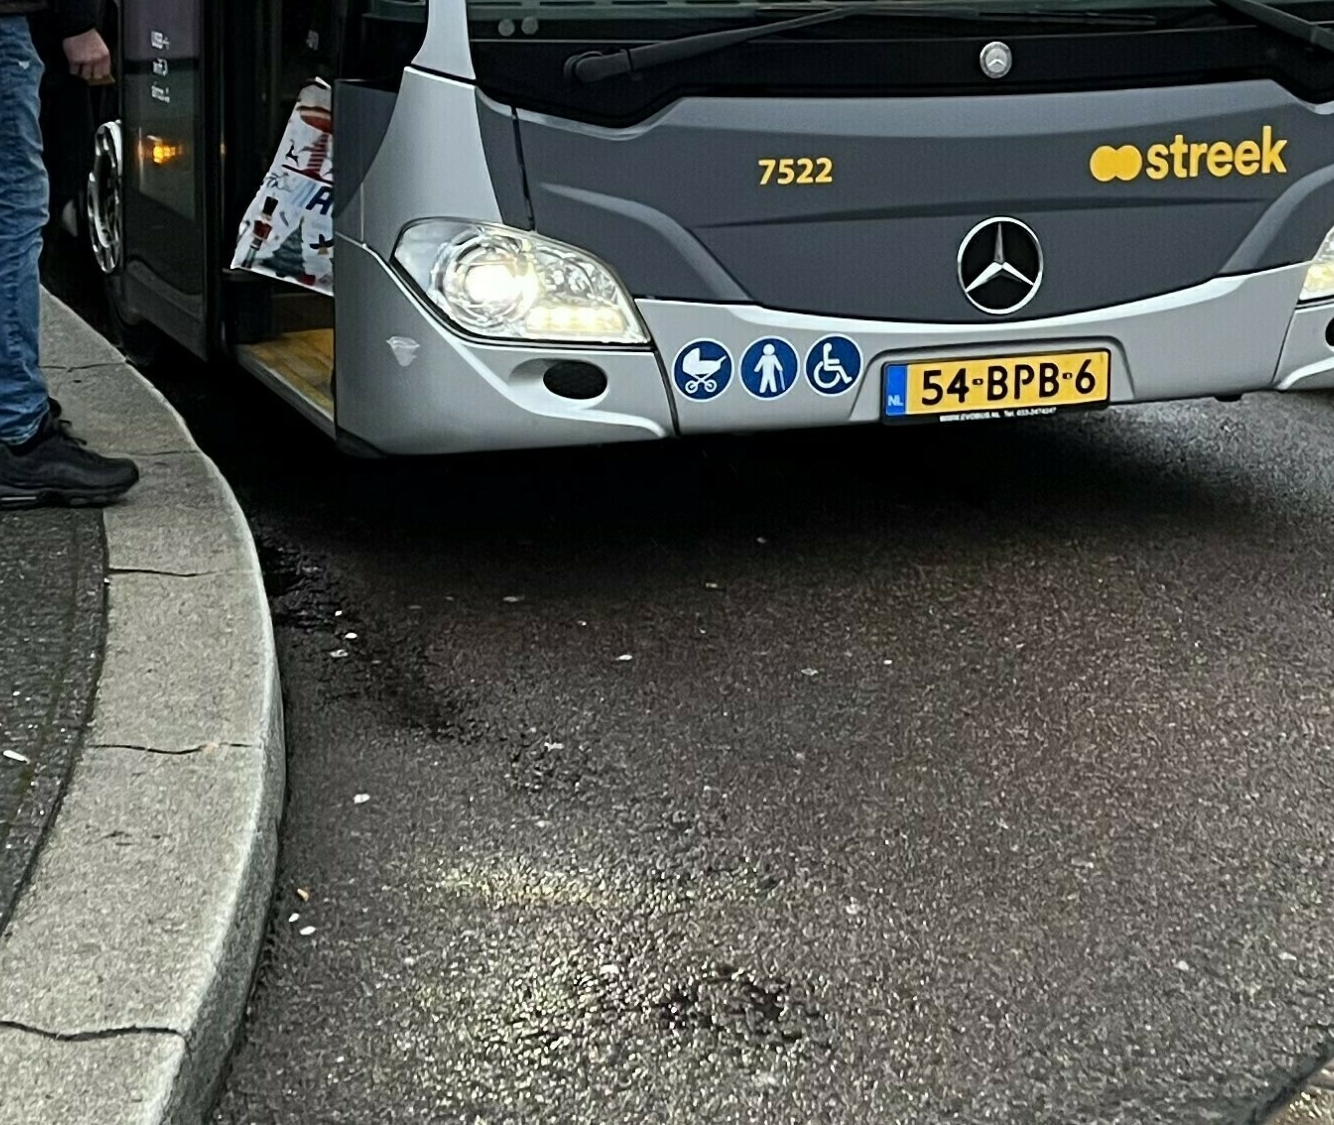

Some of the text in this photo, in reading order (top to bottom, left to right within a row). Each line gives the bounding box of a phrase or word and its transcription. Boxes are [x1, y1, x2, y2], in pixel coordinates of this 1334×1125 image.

[758, 157, 833, 185] 7522
[1145, 125, 1288, 180] streek
[887, 394, 904, 407] NL
[921, 359, 1096, 406] 54-BPB-6
